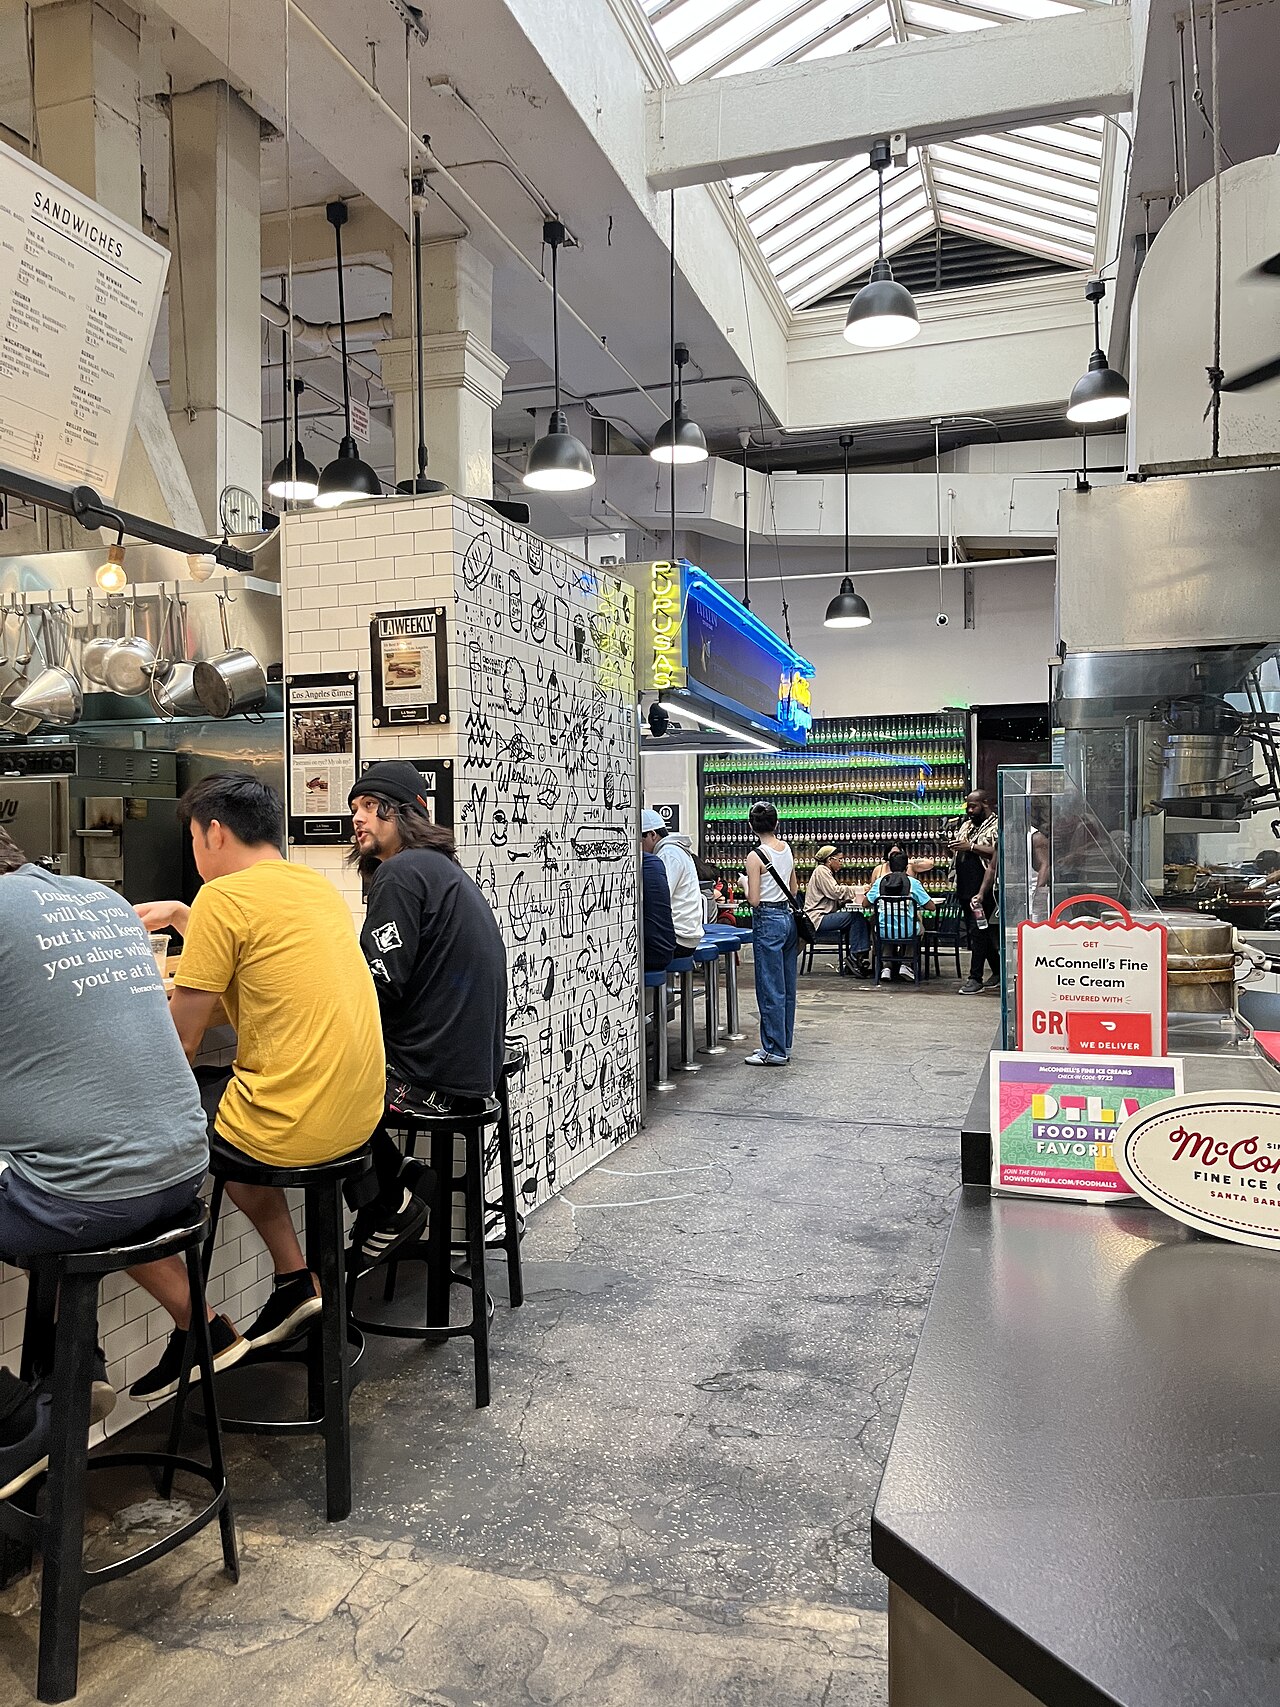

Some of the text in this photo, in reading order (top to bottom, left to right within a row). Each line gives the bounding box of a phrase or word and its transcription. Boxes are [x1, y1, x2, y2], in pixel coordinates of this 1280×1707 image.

[34, 191, 123, 258] SANDWICHES
[66, 421, 98, 439] GRILLED CHEESE
[395, 615, 433, 634] WEEKLY
[651, 561, 673, 690] PUPUSAS
[292, 688, 353, 699] Los Angeles Times
[42, 906, 77, 924] will
[97, 907, 129, 923] you,
[36, 923, 144, 950] but it will keep
[43, 954, 85, 981] you
[86, 946, 124, 964] alive
[1035, 956, 1149, 971] McConnell's Fine
[72, 967, 128, 997] you're
[129, 964, 145, 979] at
[1057, 975, 1125, 988] Ice Cream
[1059, 994, 1123, 1004] DELIVERED WITH
[1080, 1041, 1096, 1050] WE
[1098, 1042, 1140, 1051] DELIVER
[1106, 1068, 1133, 1076] CREAMS
[1032, 1094, 1141, 1124] DTLA
[1037, 1125, 1088, 1139] FOOD
[1003, 1175, 1118, 1189] DOWNTOWNLA.COM/FOODHALLS
[1194, 1171, 1231, 1185] FINE
[1240, 1177, 1268, 1190] ICE
[1210, 1190, 1247, 1202] SANTA
